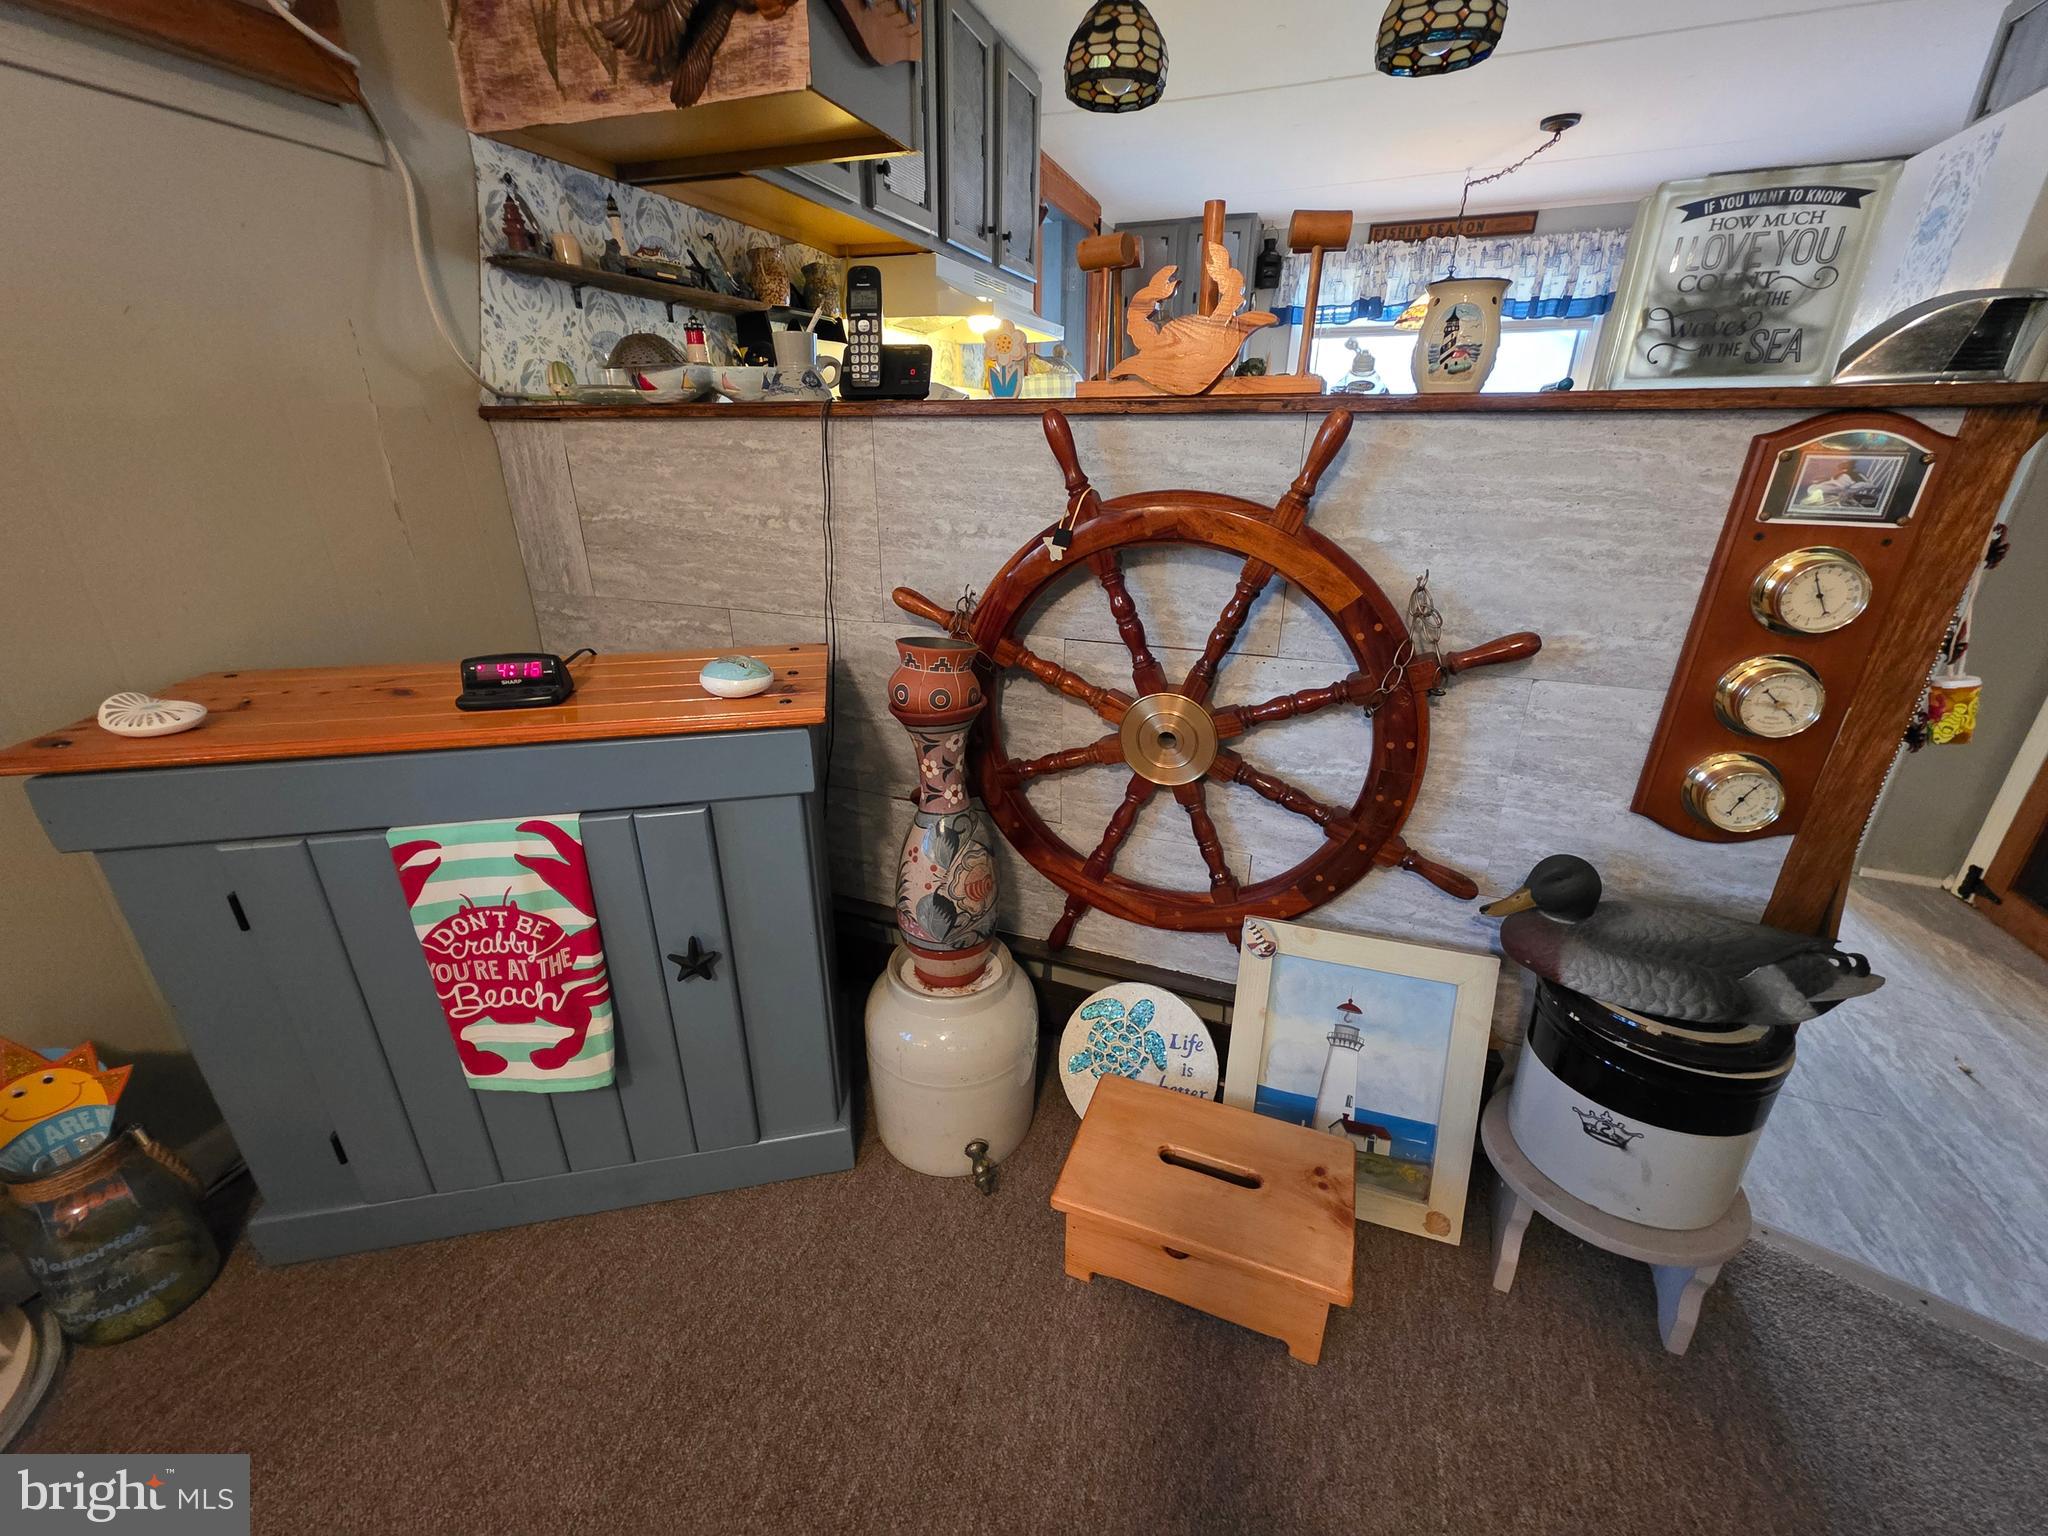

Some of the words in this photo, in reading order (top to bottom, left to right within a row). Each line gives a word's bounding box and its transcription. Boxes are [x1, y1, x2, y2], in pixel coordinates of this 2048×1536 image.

[1703, 201, 1716, 215] IF
[1719, 194, 1744, 211] YOU
[1748, 190, 1786, 206] WANT
[1788, 188, 1804, 202] TO
[1805, 189, 1847, 205] KNOW
[1373, 224, 1422, 241] FISHIN
[1708, 214, 1757, 232] HOW
[1763, 209, 1827, 228] MUCH
[1685, 230, 1771, 272] LOVE
[1775, 225, 1847, 267] YOU
[1677, 270, 1781, 293] COUNT
[1763, 290, 1793, 306] THE
[1699, 343, 1715, 359] IN
[1717, 342, 1743, 358] THE
[1743, 327, 1803, 364] SEA
[431, 910, 509, 947] DON'T
[515, 917, 551, 941] BE
[428, 959, 502, 984] YOU'RE
[508, 959, 531, 982] AT
[536, 946, 574, 981] THE
[435, 980, 569, 1019] Beach
[1168, 1033, 1204, 1059] Life
[1181, 1063, 1194, 1077] is
[45, 1110, 96, 1145] ARE
